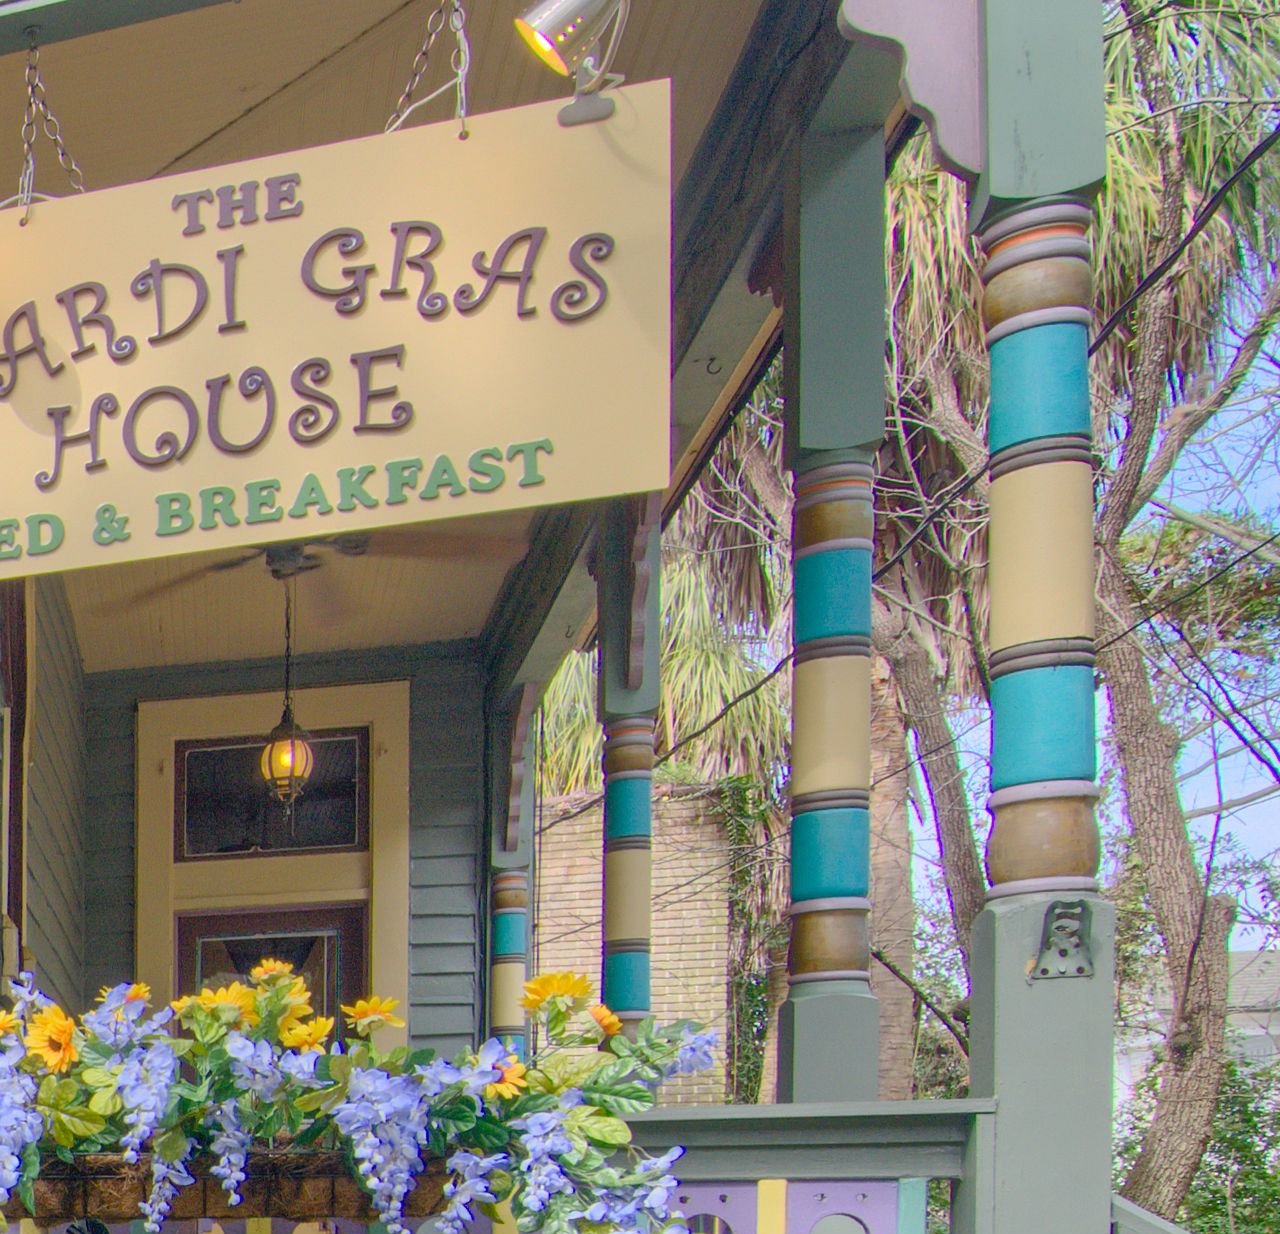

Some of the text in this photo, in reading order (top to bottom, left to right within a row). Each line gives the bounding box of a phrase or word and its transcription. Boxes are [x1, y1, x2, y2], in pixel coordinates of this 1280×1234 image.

[171, 173, 305, 238] THE
[301, 220, 615, 324] GRAS
[35, 344, 414, 490] HOUSE
[93, 505, 133, 548] &
[155, 438, 554, 537] BREAKFAST
